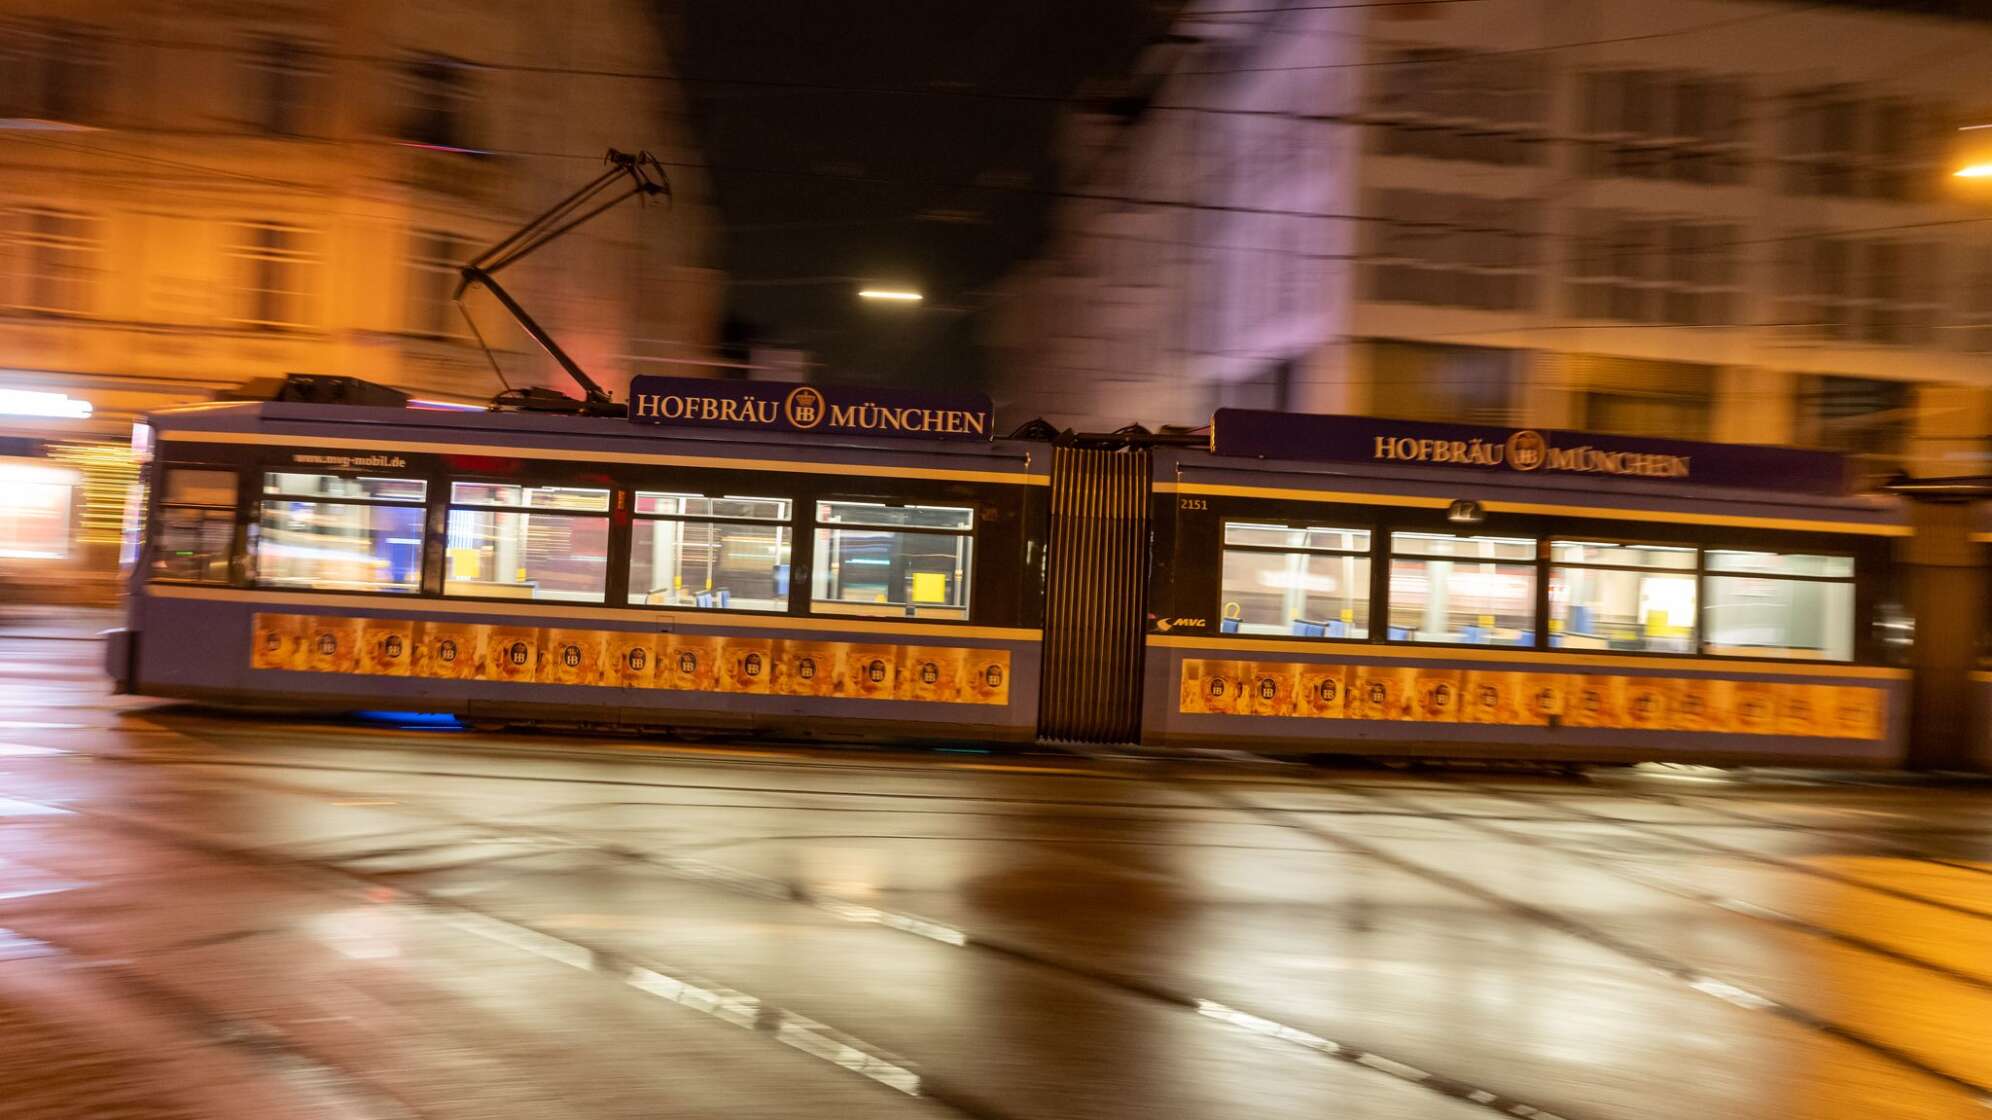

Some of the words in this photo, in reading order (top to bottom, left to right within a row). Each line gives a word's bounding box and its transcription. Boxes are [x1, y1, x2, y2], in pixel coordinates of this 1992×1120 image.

[636, 394, 780, 423] HOFBRÄU
[829, 403, 986, 434] MÜNCHEN
[1373, 436, 1505, 465] HOFBRÄU
[1546, 446, 1692, 477] MÜNCHEN
[1180, 499, 1208, 511] 2151
[1172, 618, 1206, 627] MVG
